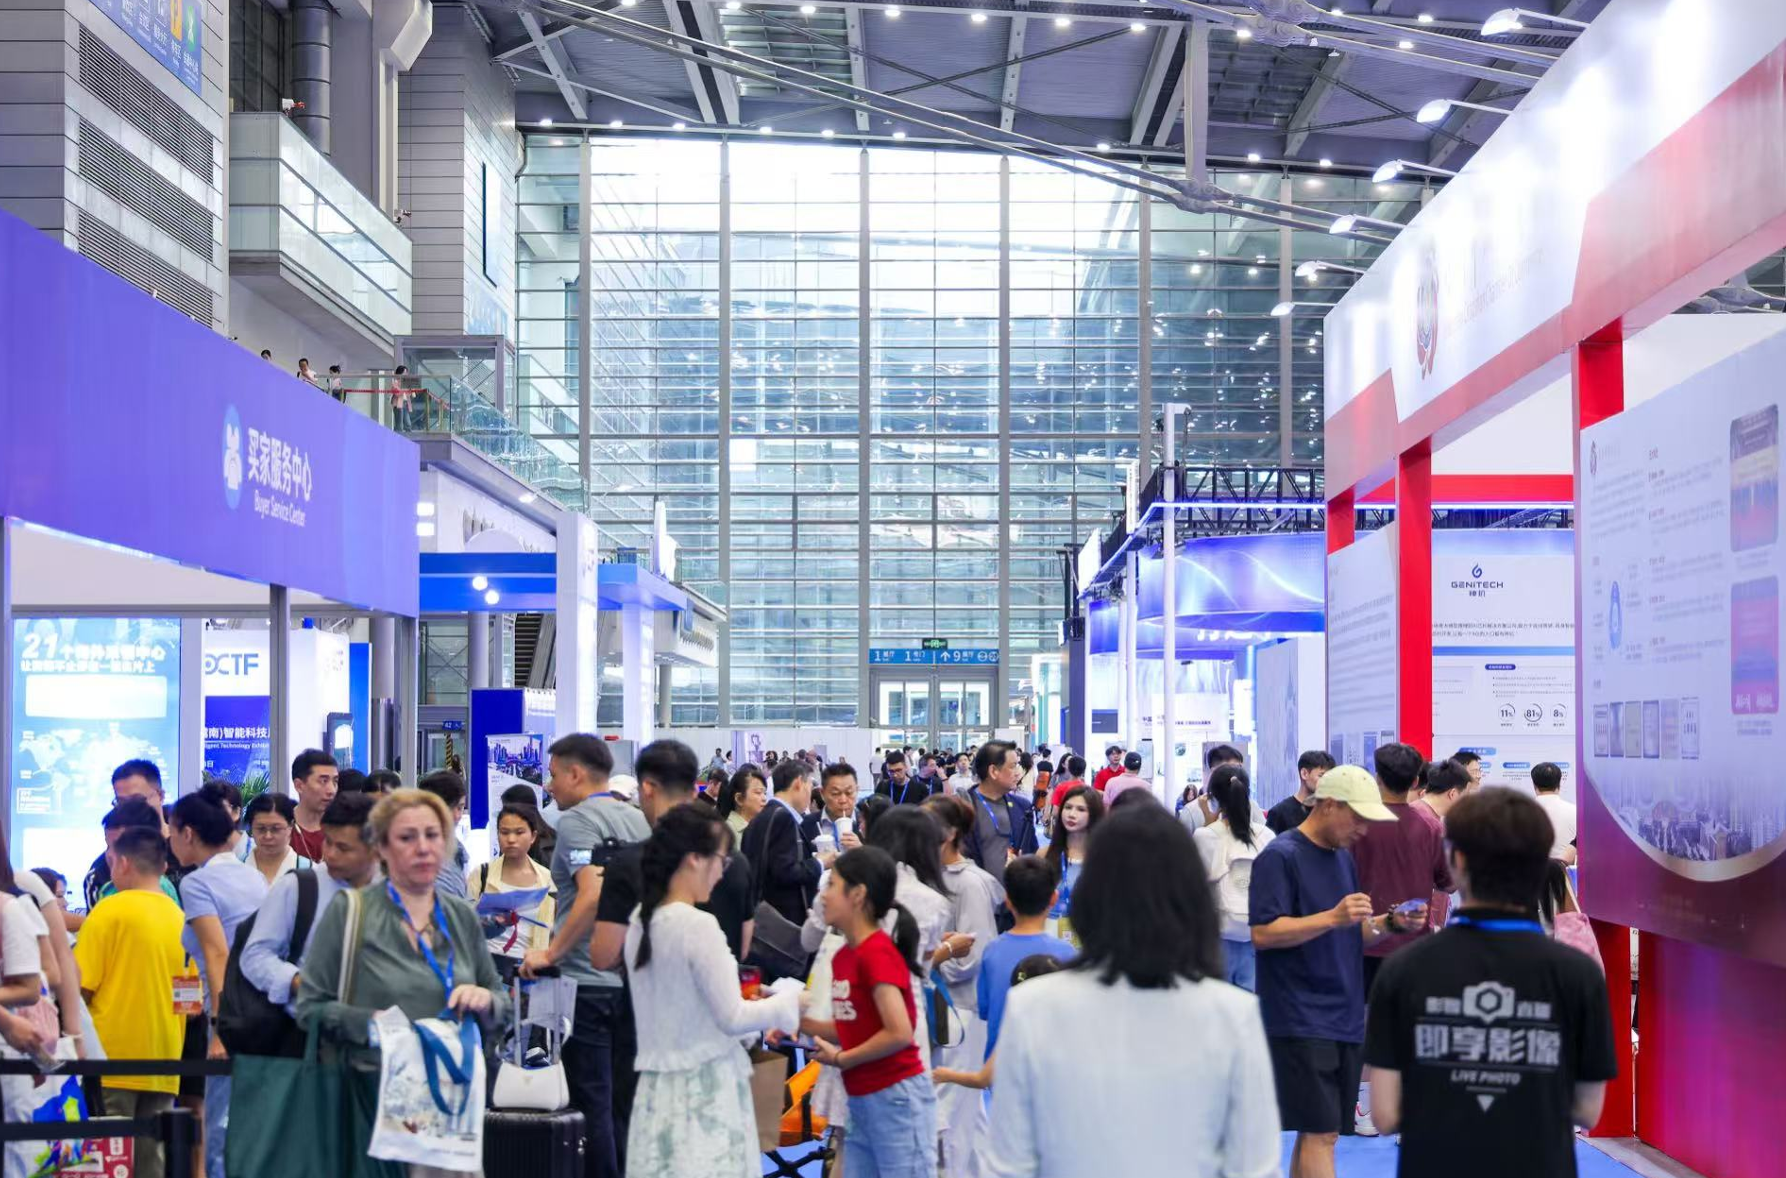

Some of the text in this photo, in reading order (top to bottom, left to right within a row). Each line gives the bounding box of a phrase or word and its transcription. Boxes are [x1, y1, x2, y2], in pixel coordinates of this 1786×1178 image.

[248, 427, 312, 502] 买家服务中心
[254, 490, 306, 527] Buyer Service Center
[874, 651, 881, 661] 1
[905, 651, 911, 661] 1
[953, 651, 961, 661] 9
[1501, 709, 1514, 717] 11%
[1526, 709, 1540, 717] 81%
[1553, 709, 1564, 717] 8%
[205, 726, 270, 739] 南)智能科技
[1415, 1024, 1561, 1065] 即享影像
[1451, 1070, 1521, 1085] LIVE PHOTO
